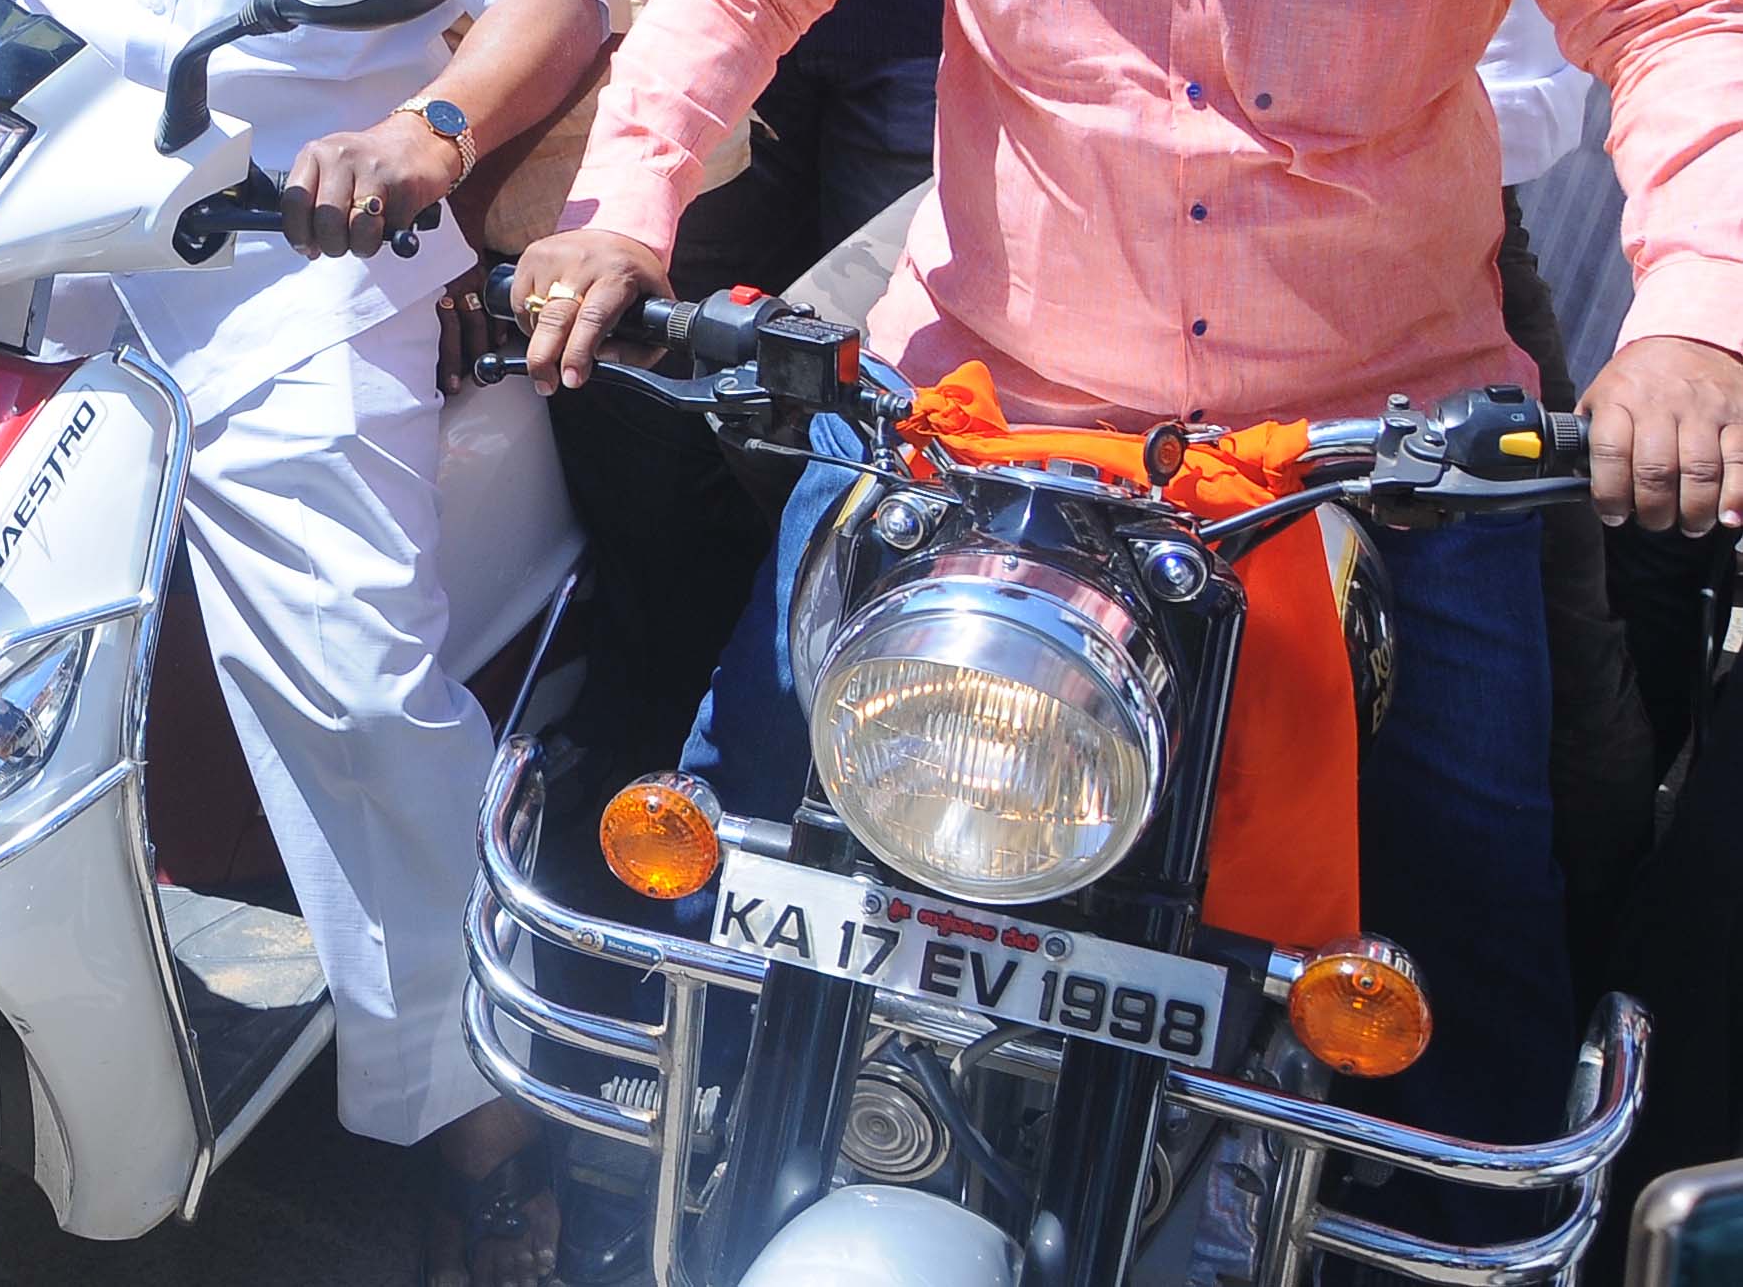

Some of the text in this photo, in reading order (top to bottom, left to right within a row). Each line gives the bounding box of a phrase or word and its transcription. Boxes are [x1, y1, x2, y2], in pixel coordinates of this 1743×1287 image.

[719, 890, 1206, 1057] KA 17 EV 1998
